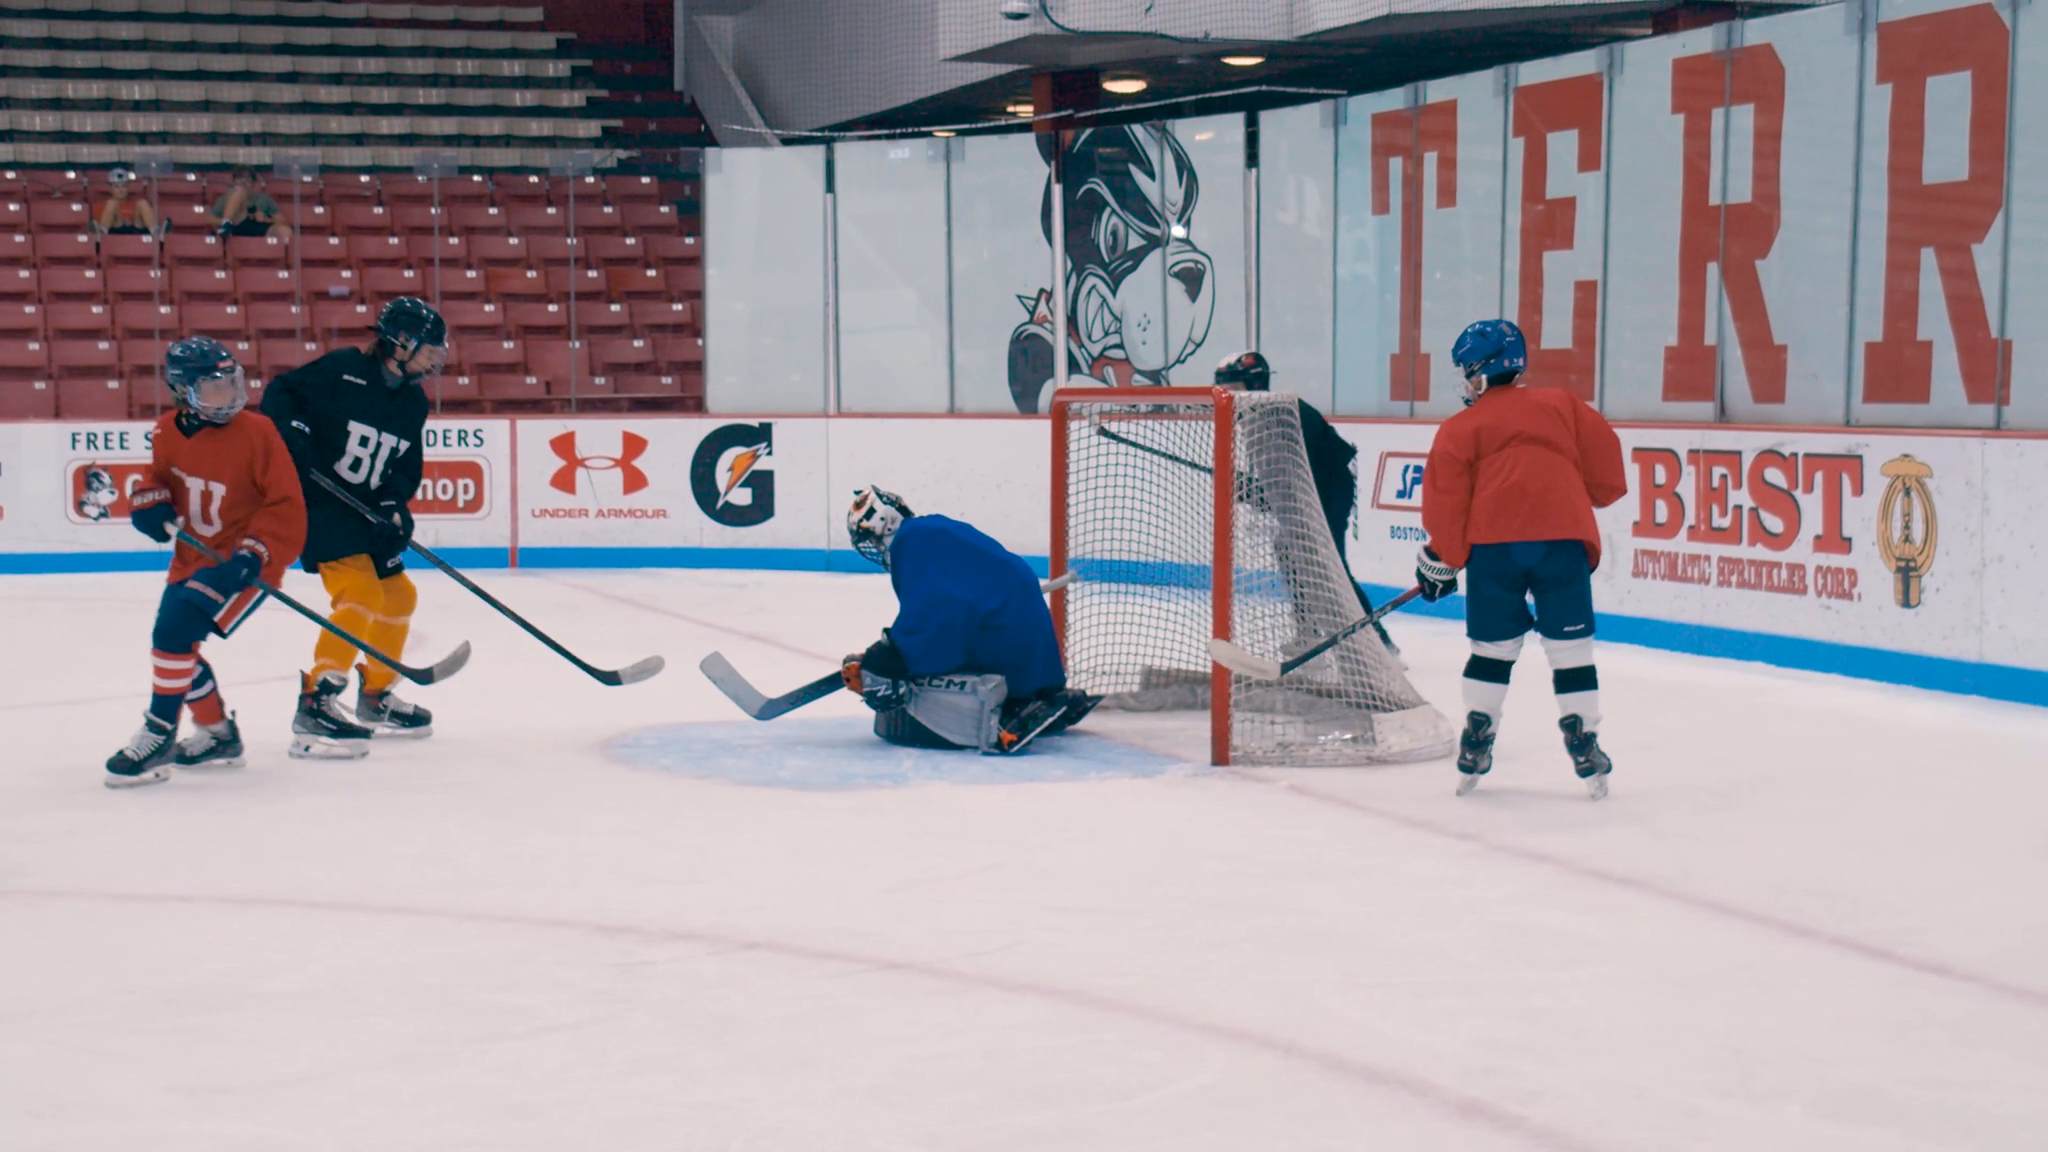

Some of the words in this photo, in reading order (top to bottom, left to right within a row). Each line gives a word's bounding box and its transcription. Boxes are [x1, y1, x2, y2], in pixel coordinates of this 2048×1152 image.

[71, 431, 130, 451] FREE
[333, 419, 411, 491] BU
[425, 429, 485, 448] DERS
[690, 422, 775, 527] G
[531, 508, 590, 519] UNDER
[595, 508, 668, 519] ARMOUR
[1631, 447, 1863, 555] BEST
[1390, 525, 1427, 542] BOSTON
[1631, 548, 1711, 586] AUTOMATIC
[1717, 555, 1808, 596] SPRINKLER
[1813, 564, 1862, 603] CORP.
